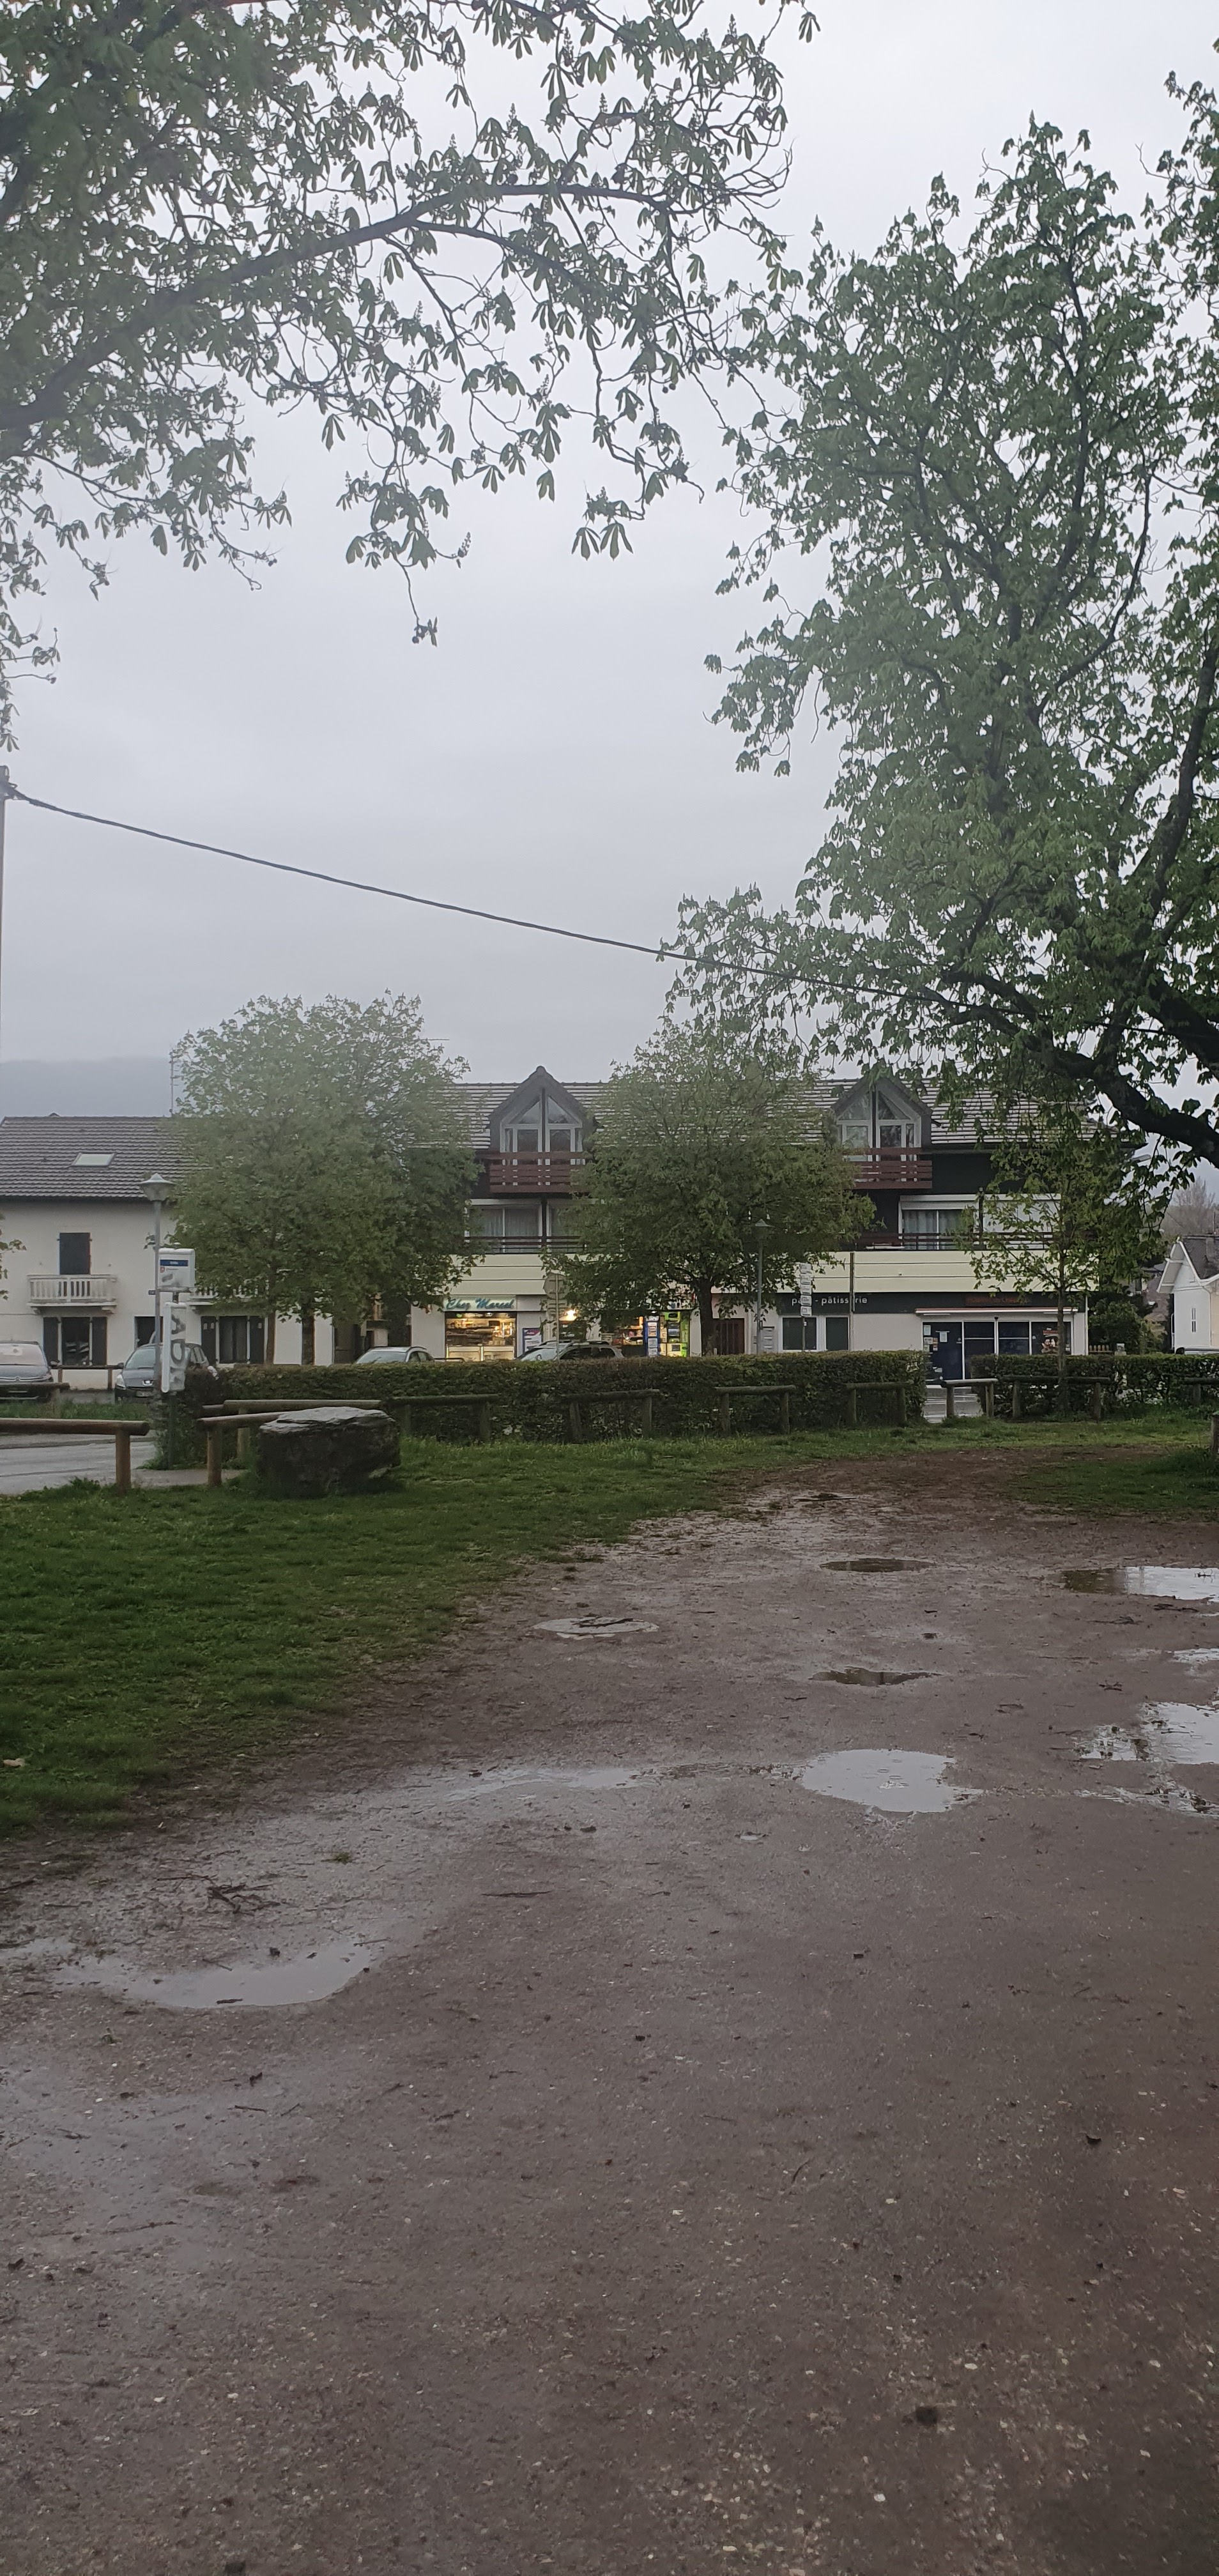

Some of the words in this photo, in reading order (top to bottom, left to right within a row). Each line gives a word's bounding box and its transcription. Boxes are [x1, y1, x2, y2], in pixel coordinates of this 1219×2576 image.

[447, 1298, 471, 1310] Chez
[475, 1298, 514, 1309] Marcel
[821, 1296, 868, 1306] pâtissrie
